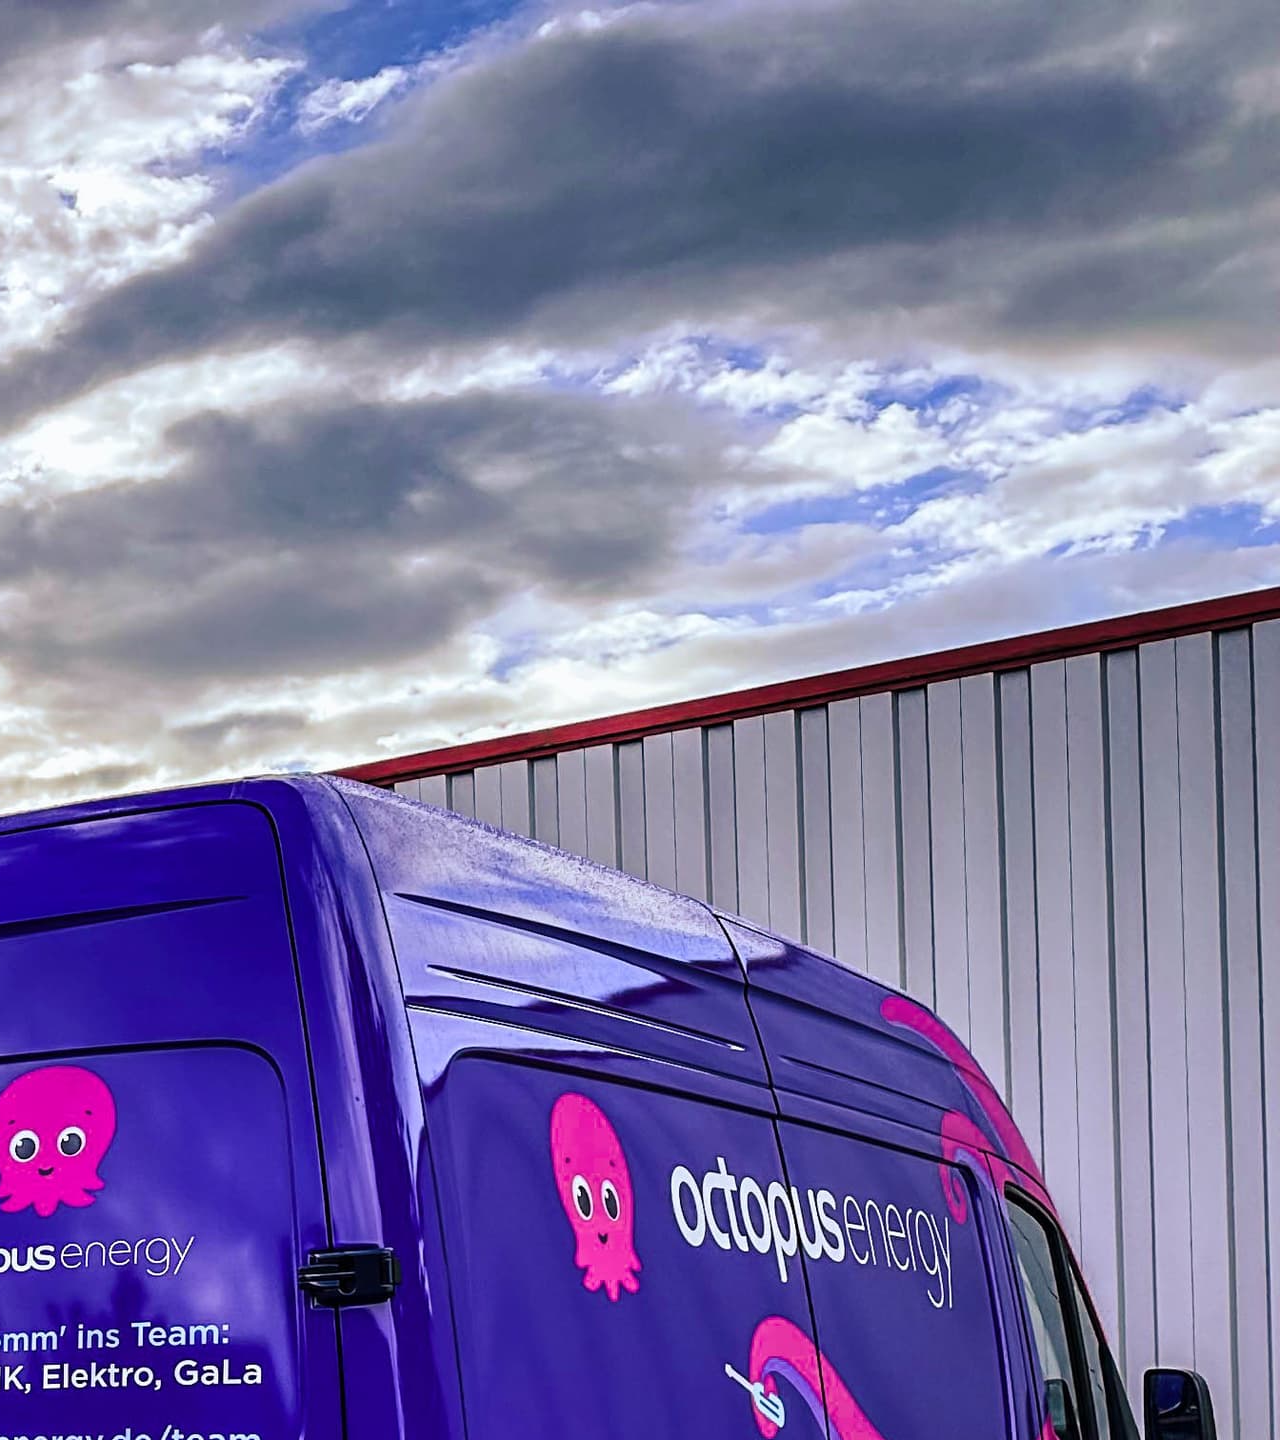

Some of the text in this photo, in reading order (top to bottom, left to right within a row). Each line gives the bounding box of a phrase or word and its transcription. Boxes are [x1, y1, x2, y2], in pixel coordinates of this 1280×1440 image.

[77, 1323, 120, 1350] ins
[130, 1321, 229, 1347] Team:
[42, 1362, 162, 1391] Elektro,
[174, 1358, 262, 1386] GaLa
